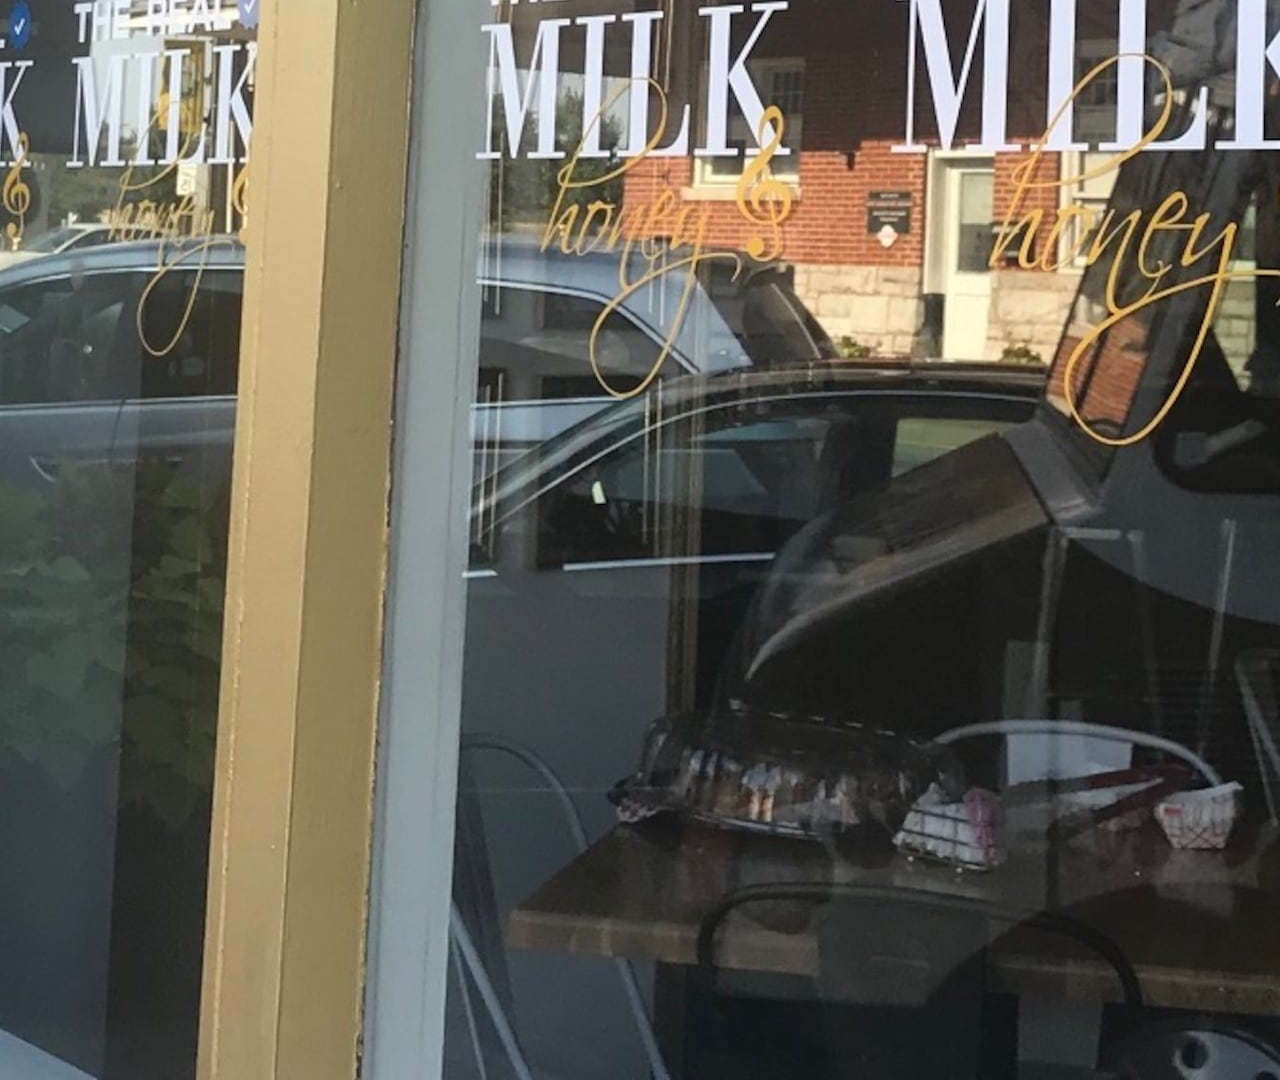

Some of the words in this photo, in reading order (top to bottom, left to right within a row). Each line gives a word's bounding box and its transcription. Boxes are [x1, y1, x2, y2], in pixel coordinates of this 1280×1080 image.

[73, 0, 132, 43] THE
[475, 0, 791, 160] MILK
[65, 43, 258, 168] MILK
[542, 76, 741, 400] honey
